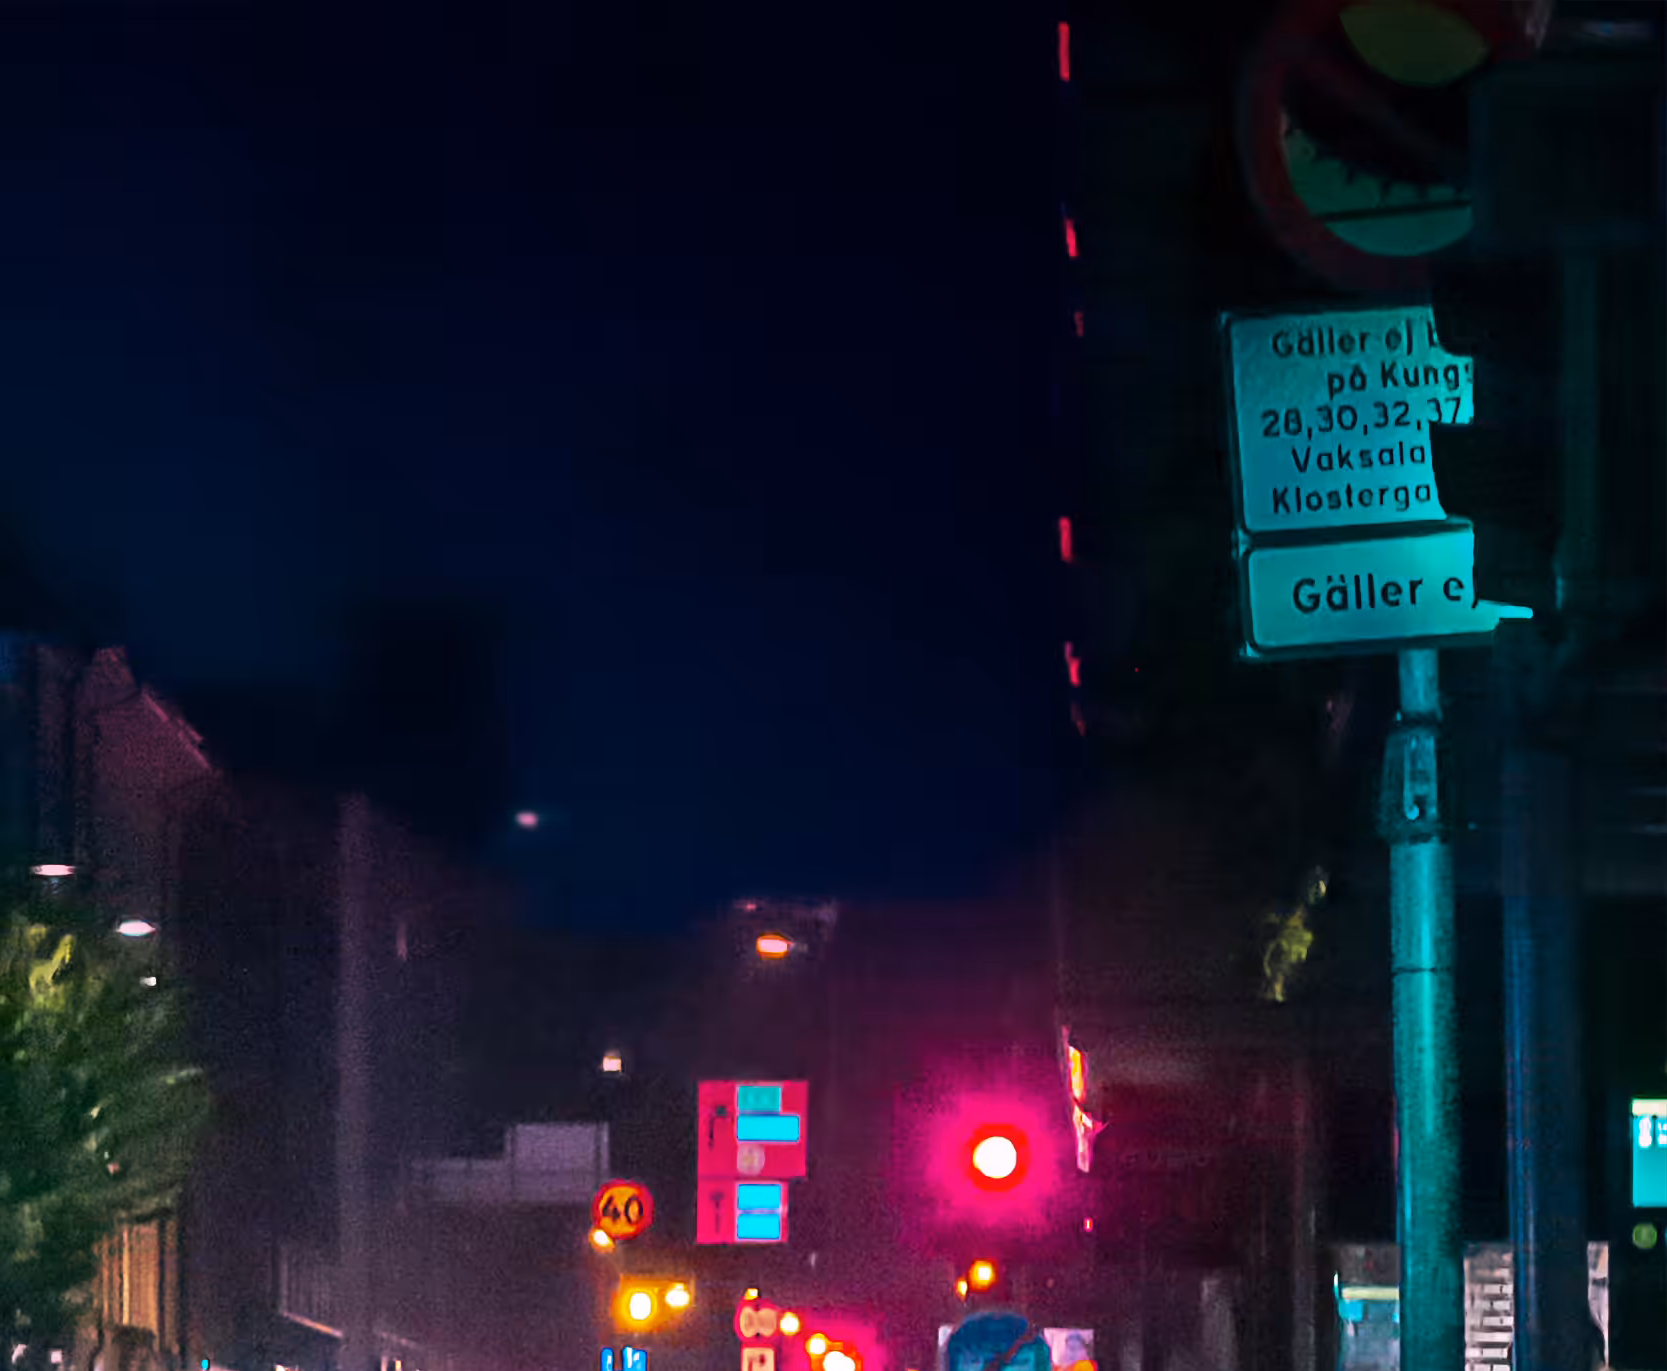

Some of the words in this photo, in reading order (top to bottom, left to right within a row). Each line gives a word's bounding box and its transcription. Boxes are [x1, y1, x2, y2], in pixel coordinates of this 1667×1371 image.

[1327, 363, 1367, 401] på
[1379, 360, 1473, 391] Kung
[1291, 440, 1426, 474] Vaksala
[1292, 572, 1424, 614] Gäller
[601, 1196, 644, 1225] 40
